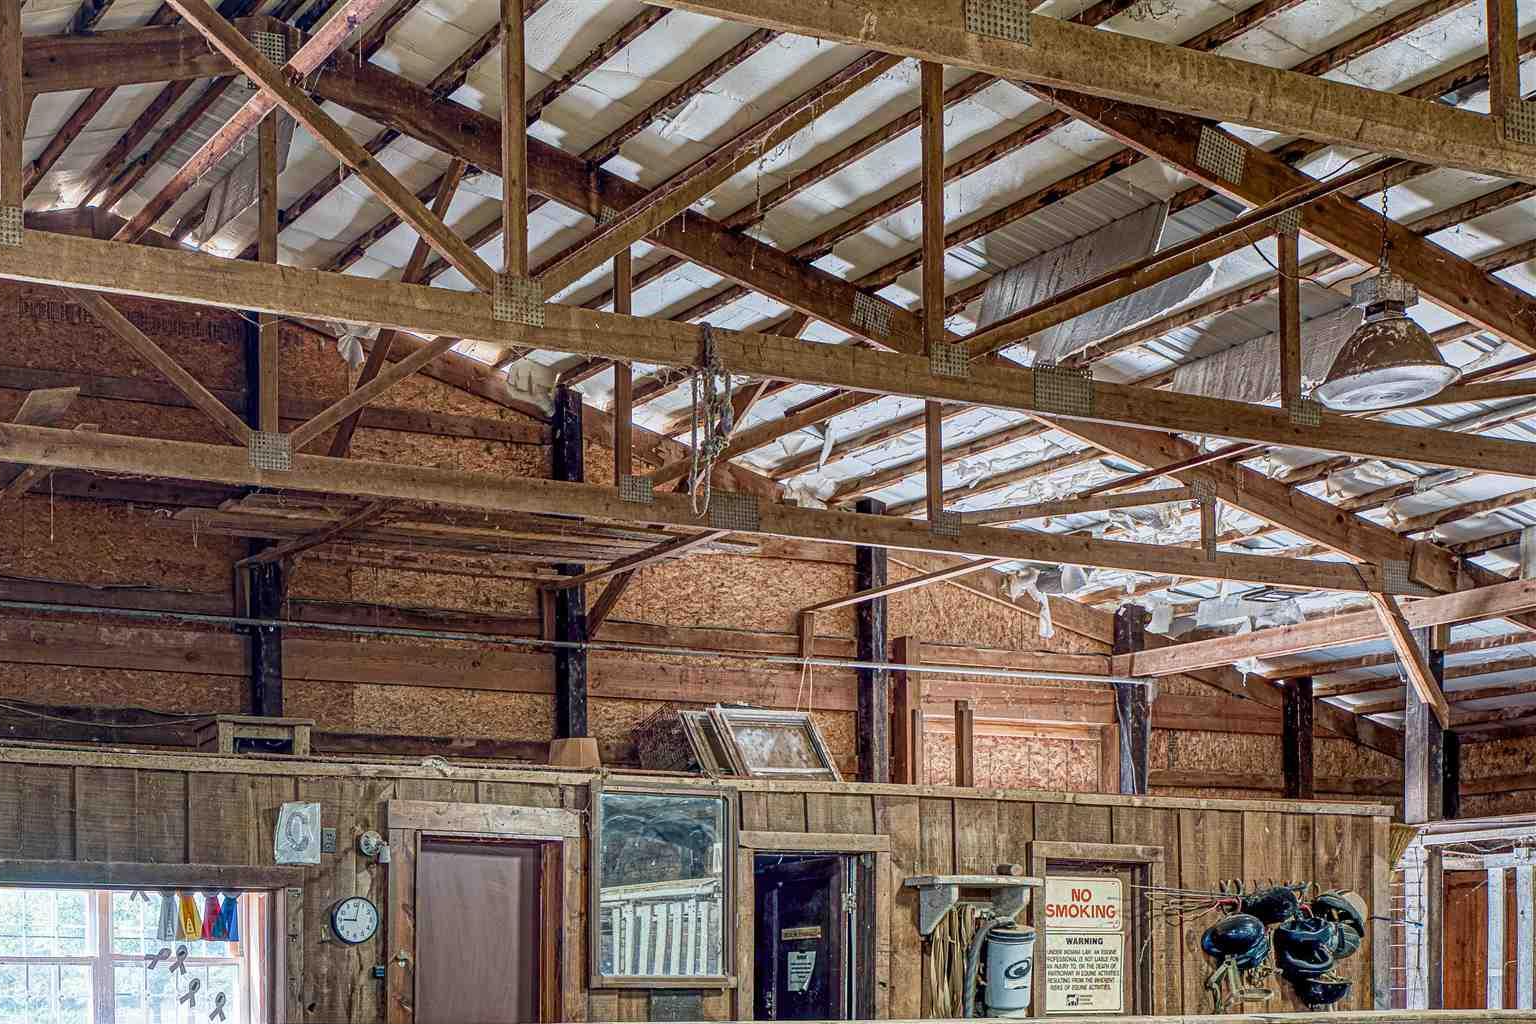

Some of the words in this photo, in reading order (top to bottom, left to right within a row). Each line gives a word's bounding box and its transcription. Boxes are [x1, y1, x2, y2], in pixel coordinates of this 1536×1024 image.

[1071, 888, 1092, 902] NO
[1045, 903, 1116, 918] SMOKING
[1065, 937, 1104, 945] WARNING
